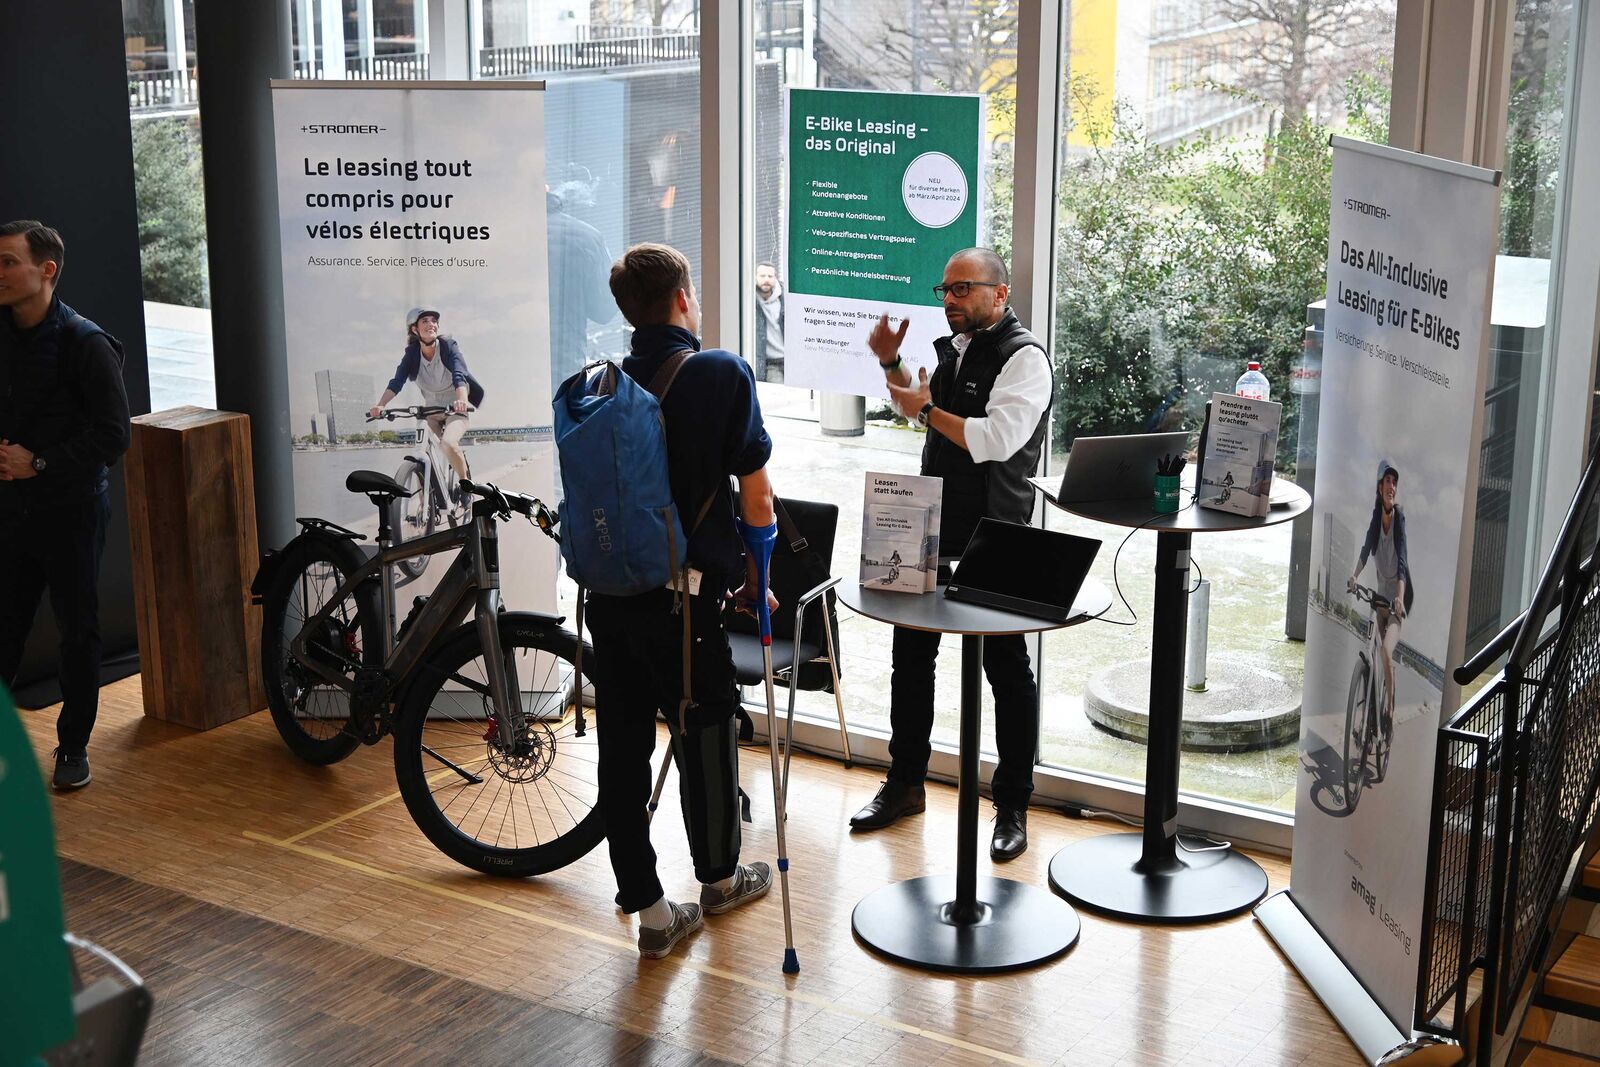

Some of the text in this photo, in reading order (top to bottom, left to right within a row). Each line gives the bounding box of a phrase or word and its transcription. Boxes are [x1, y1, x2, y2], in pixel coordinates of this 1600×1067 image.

[805, 116, 852, 132] E-Bike
[857, 118, 916, 139] Leasing
[805, 136, 896, 156] das Original
[304, 158, 472, 181] Le leasing tout
[812, 180, 837, 188] Flexible
[306, 189, 454, 212] compris pour
[812, 191, 868, 200] Kundenangebote
[812, 210, 886, 221] Attraktive Konditionen
[306, 221, 490, 244] vélos électriques
[812, 229, 915, 243] Velo-spezifisches Vertragspaket
[812, 248, 884, 260] Online-Antragssystem
[308, 256, 365, 266] Assurance.
[367, 256, 407, 267] Service.
[410, 256, 443, 267] Pièces
[811, 267, 910, 284] Persönliche Handelsbetreuung
[1341, 240, 1448, 300] Das All-Inclusive
[817, 309, 841, 317] wissen,
[1338, 281, 1460, 350] Leasing für E-Bikes
[804, 317, 825, 325] fragen
[816, 337, 850, 347] Waldburger
[1221, 401, 1243, 409] Prendre
[1220, 409, 1240, 418] leasing
[891, 488, 913, 496] kaufen
[1351, 876, 1376, 915] amag
[1380, 904, 1411, 955] Leasing
